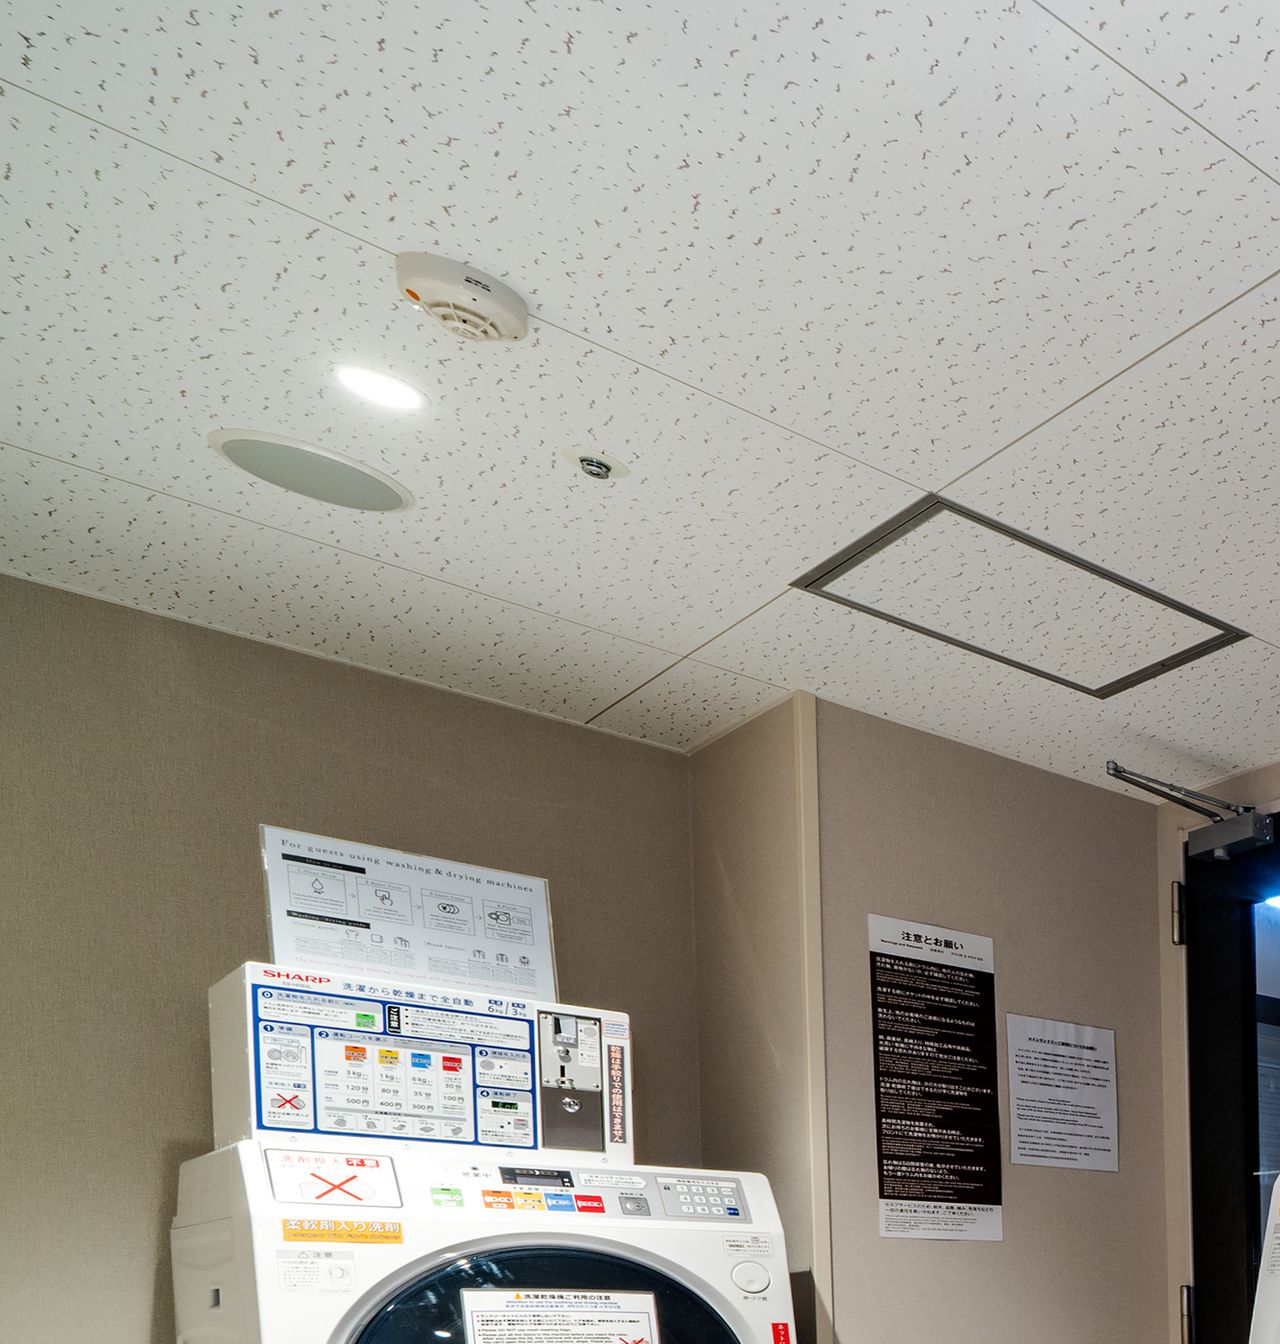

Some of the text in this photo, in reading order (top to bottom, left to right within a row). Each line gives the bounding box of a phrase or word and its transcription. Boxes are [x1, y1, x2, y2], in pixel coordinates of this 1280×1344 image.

[281, 839, 534, 893] For guests using washing & drying machines
[901, 930, 964, 950] 注意とお願い
[263, 970, 331, 985] SHARP
[342, 981, 475, 1007] 洗濯から乾燥まで全自動
[345, 1083, 369, 1094] 120分
[346, 1096, 370, 1107] 500円
[285, 1219, 400, 1234] 柔軟剤入り洗剤
